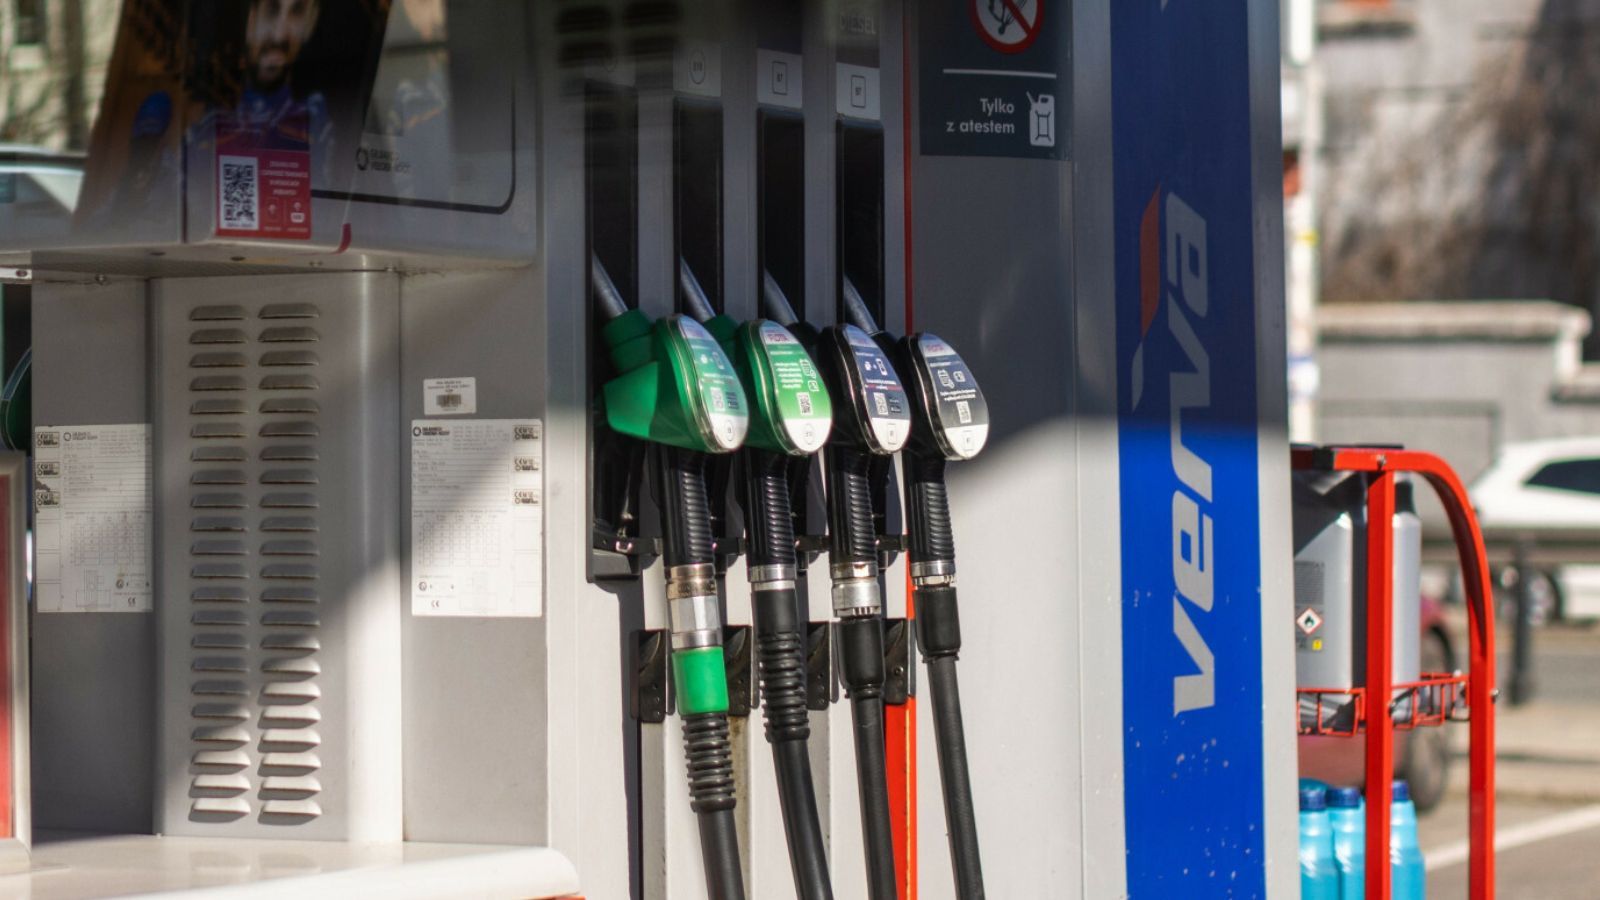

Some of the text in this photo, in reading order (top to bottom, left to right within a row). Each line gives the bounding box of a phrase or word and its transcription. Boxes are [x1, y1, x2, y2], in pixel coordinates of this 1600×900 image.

[980, 98, 1015, 117] Tylko
[946, 119, 1015, 134] z atestem
